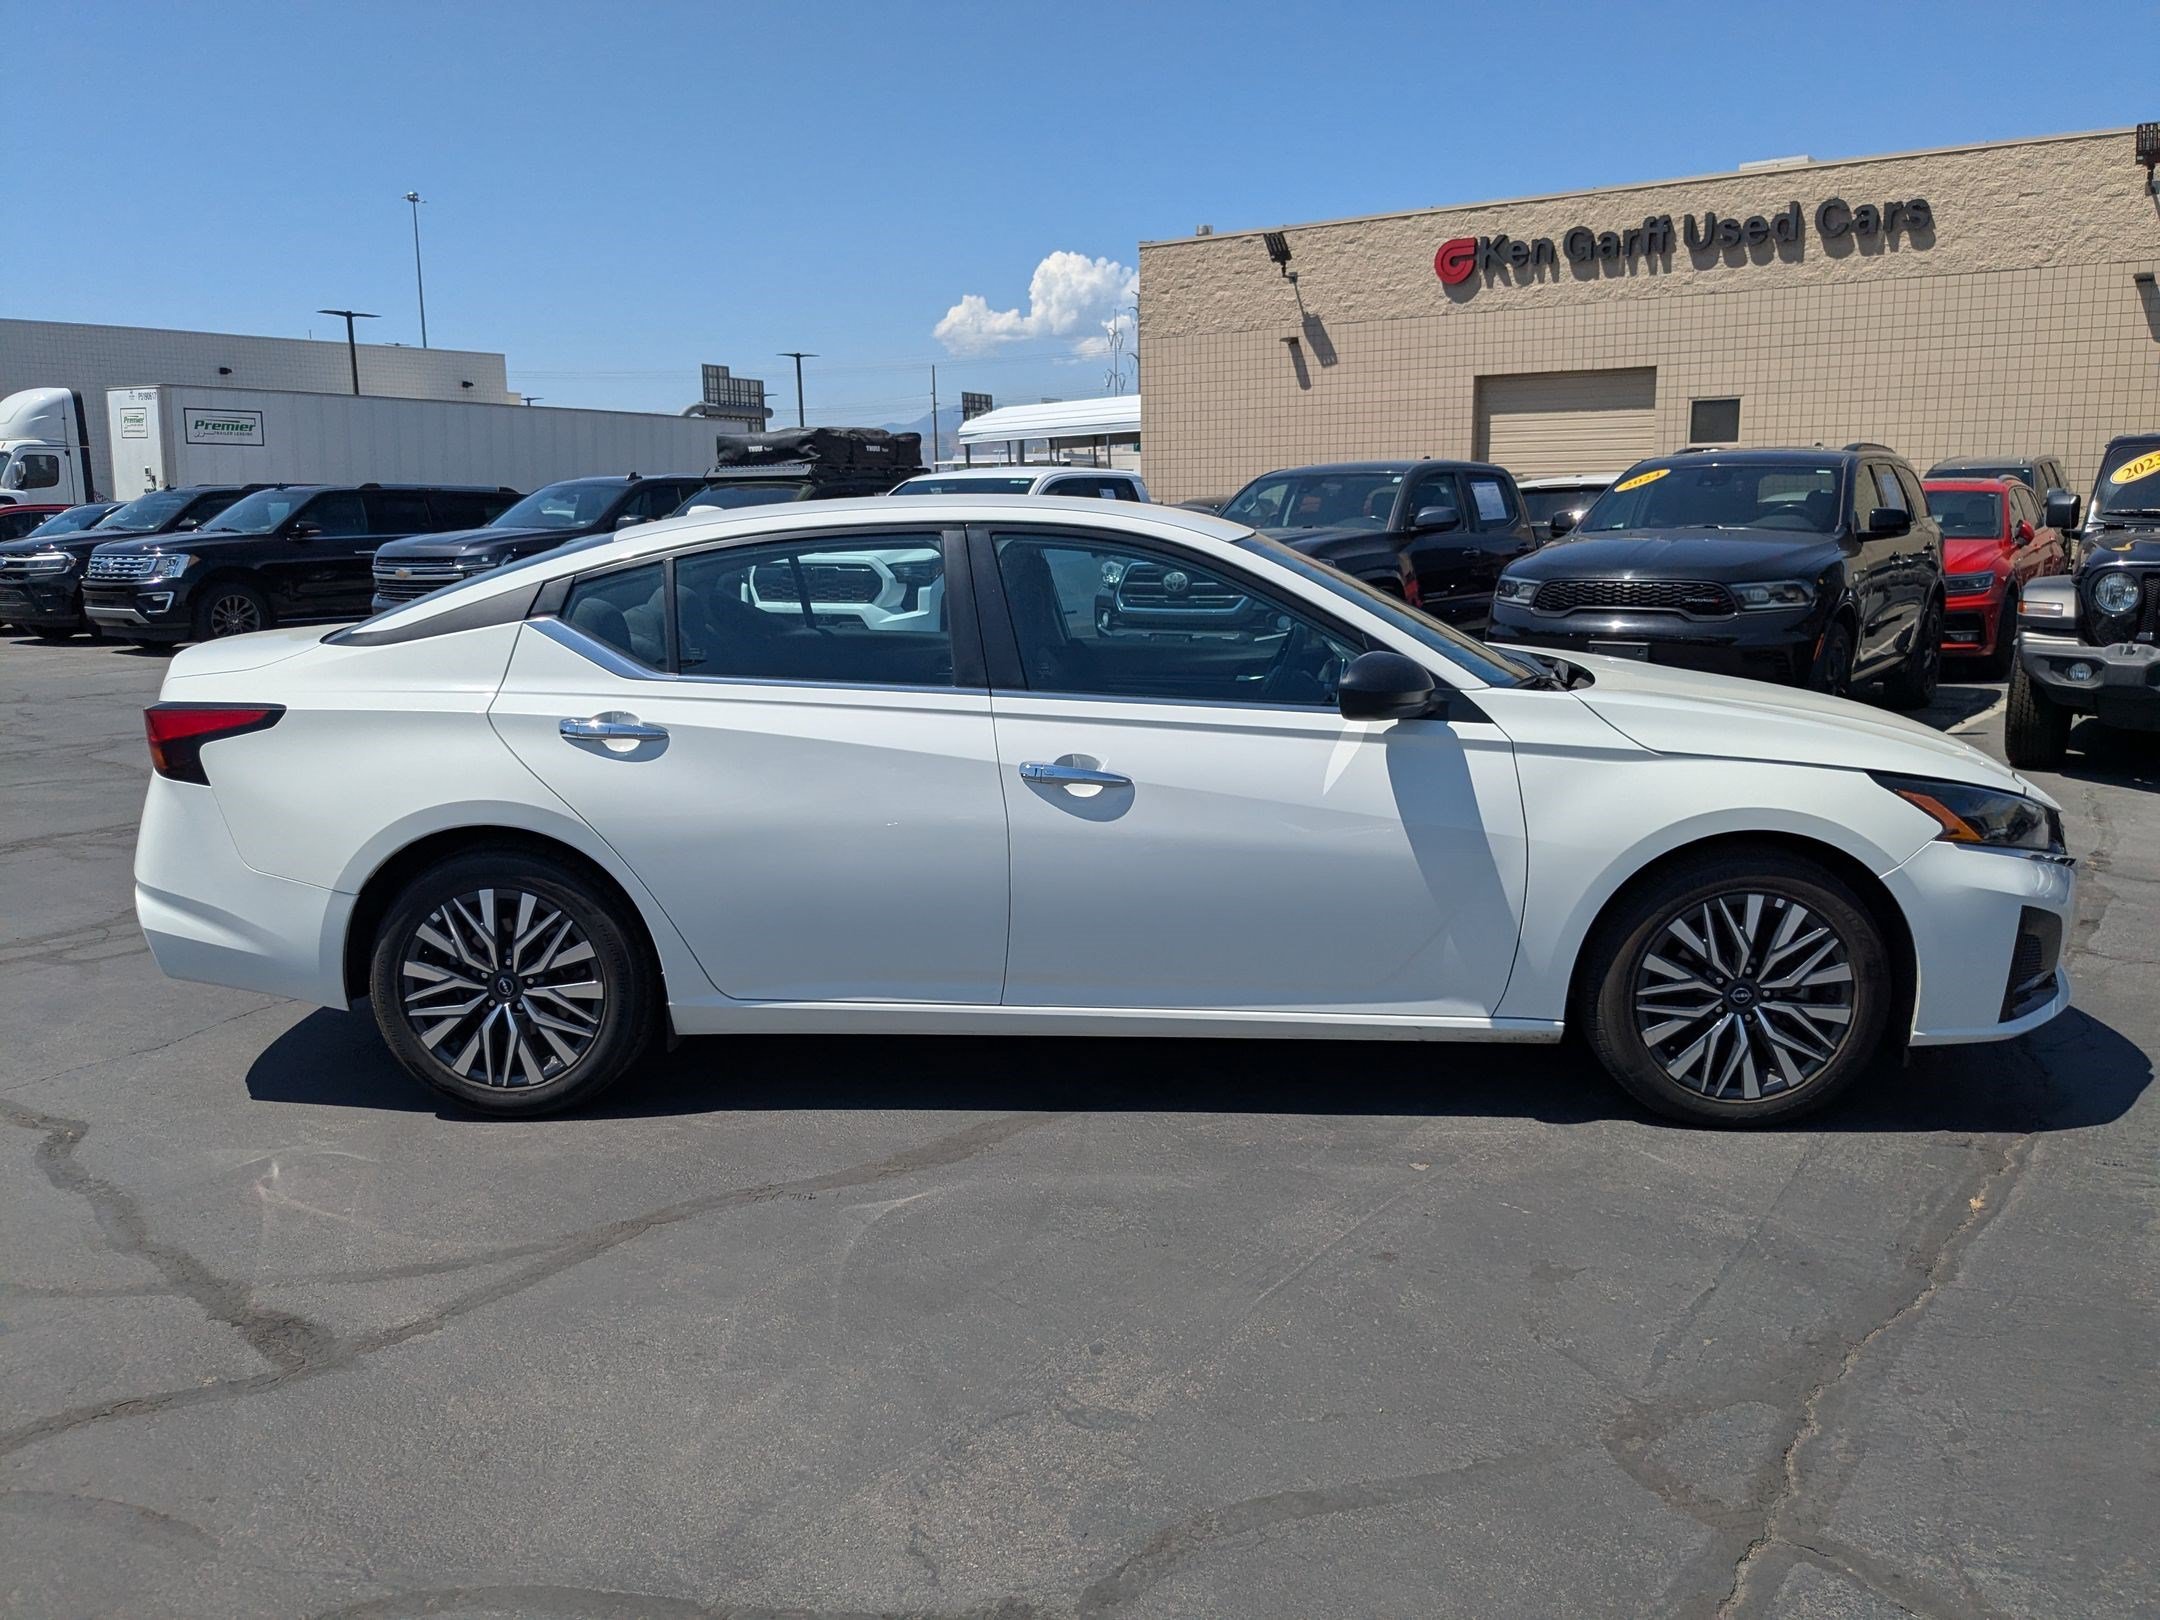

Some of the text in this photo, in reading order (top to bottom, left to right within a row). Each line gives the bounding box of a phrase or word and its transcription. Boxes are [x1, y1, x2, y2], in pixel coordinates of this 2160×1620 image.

[1478, 234, 1556, 270] Ken
[1563, 214, 1675, 263] Garff
[1684, 201, 1804, 249] Used
[1815, 198, 1933, 239] Cars
[194, 420, 256, 432] Premier
